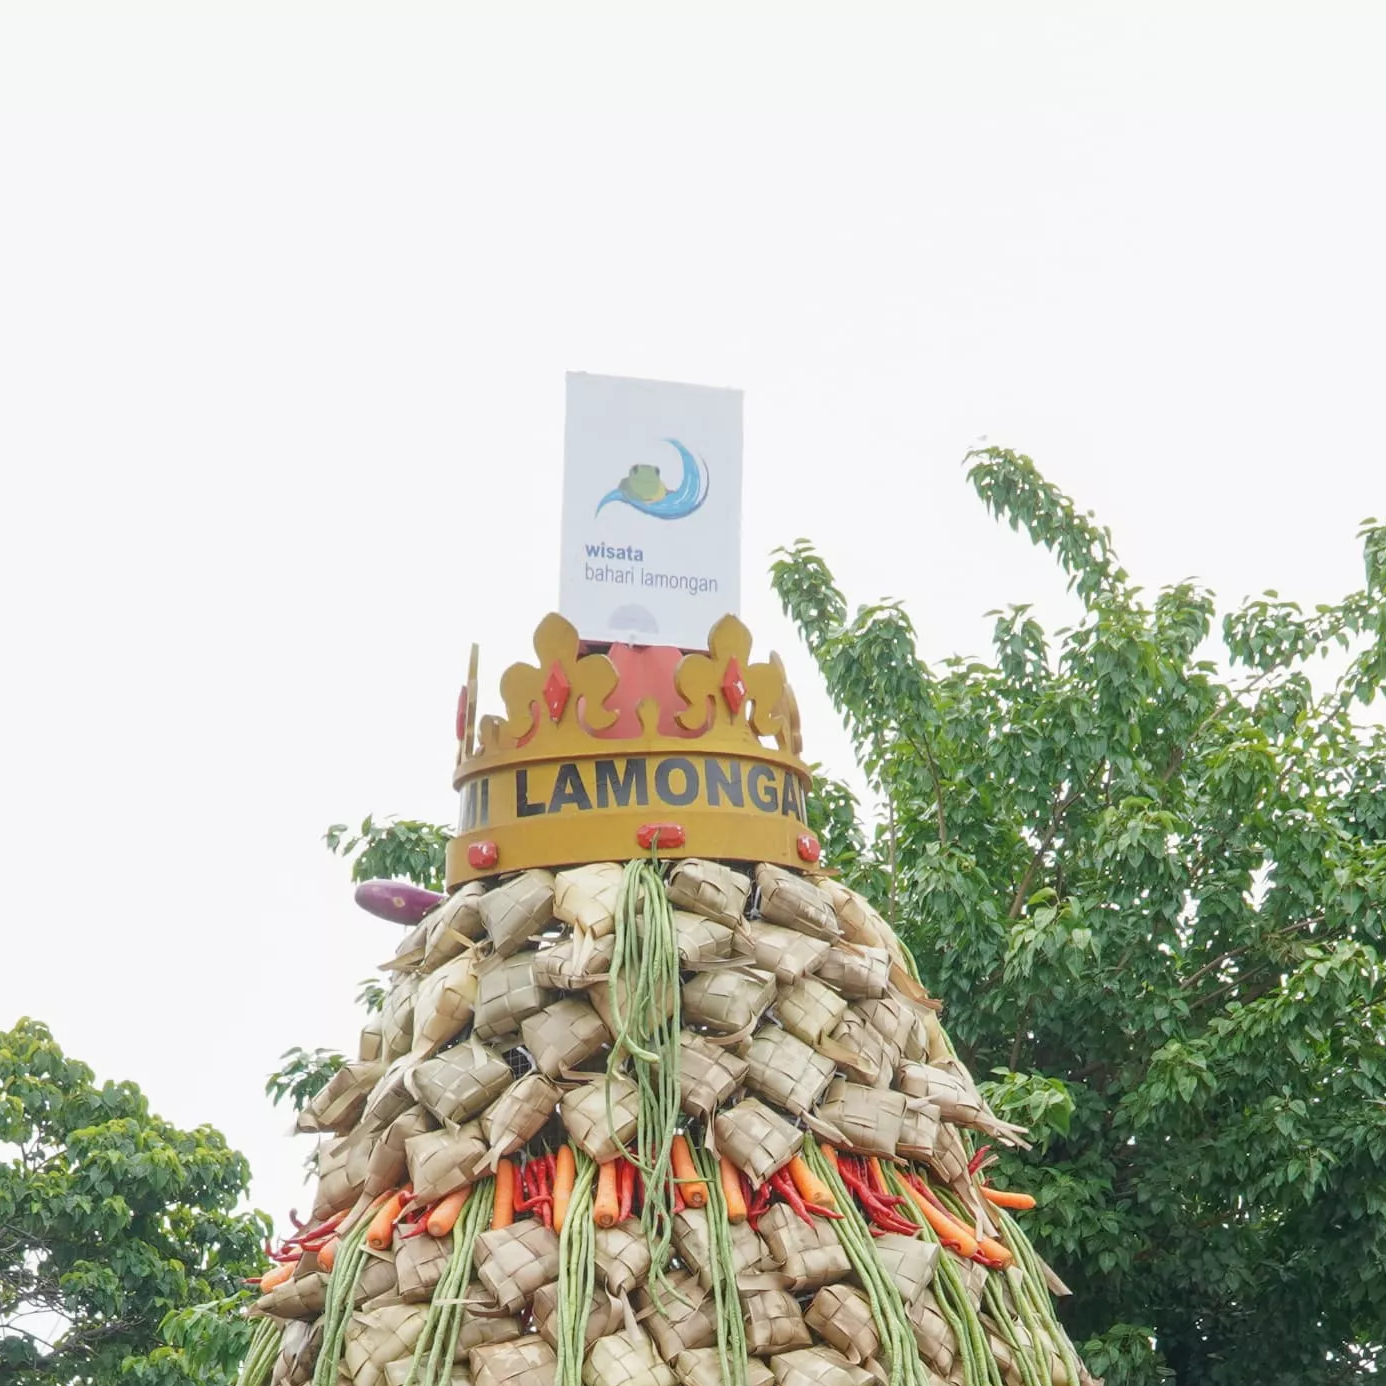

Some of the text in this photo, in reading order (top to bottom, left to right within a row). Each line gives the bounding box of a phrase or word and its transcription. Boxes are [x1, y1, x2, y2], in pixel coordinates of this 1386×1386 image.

[585, 541, 644, 562] wisata
[585, 561, 718, 596] bahari lamongan
[515, 757, 807, 823] LAMONGA
